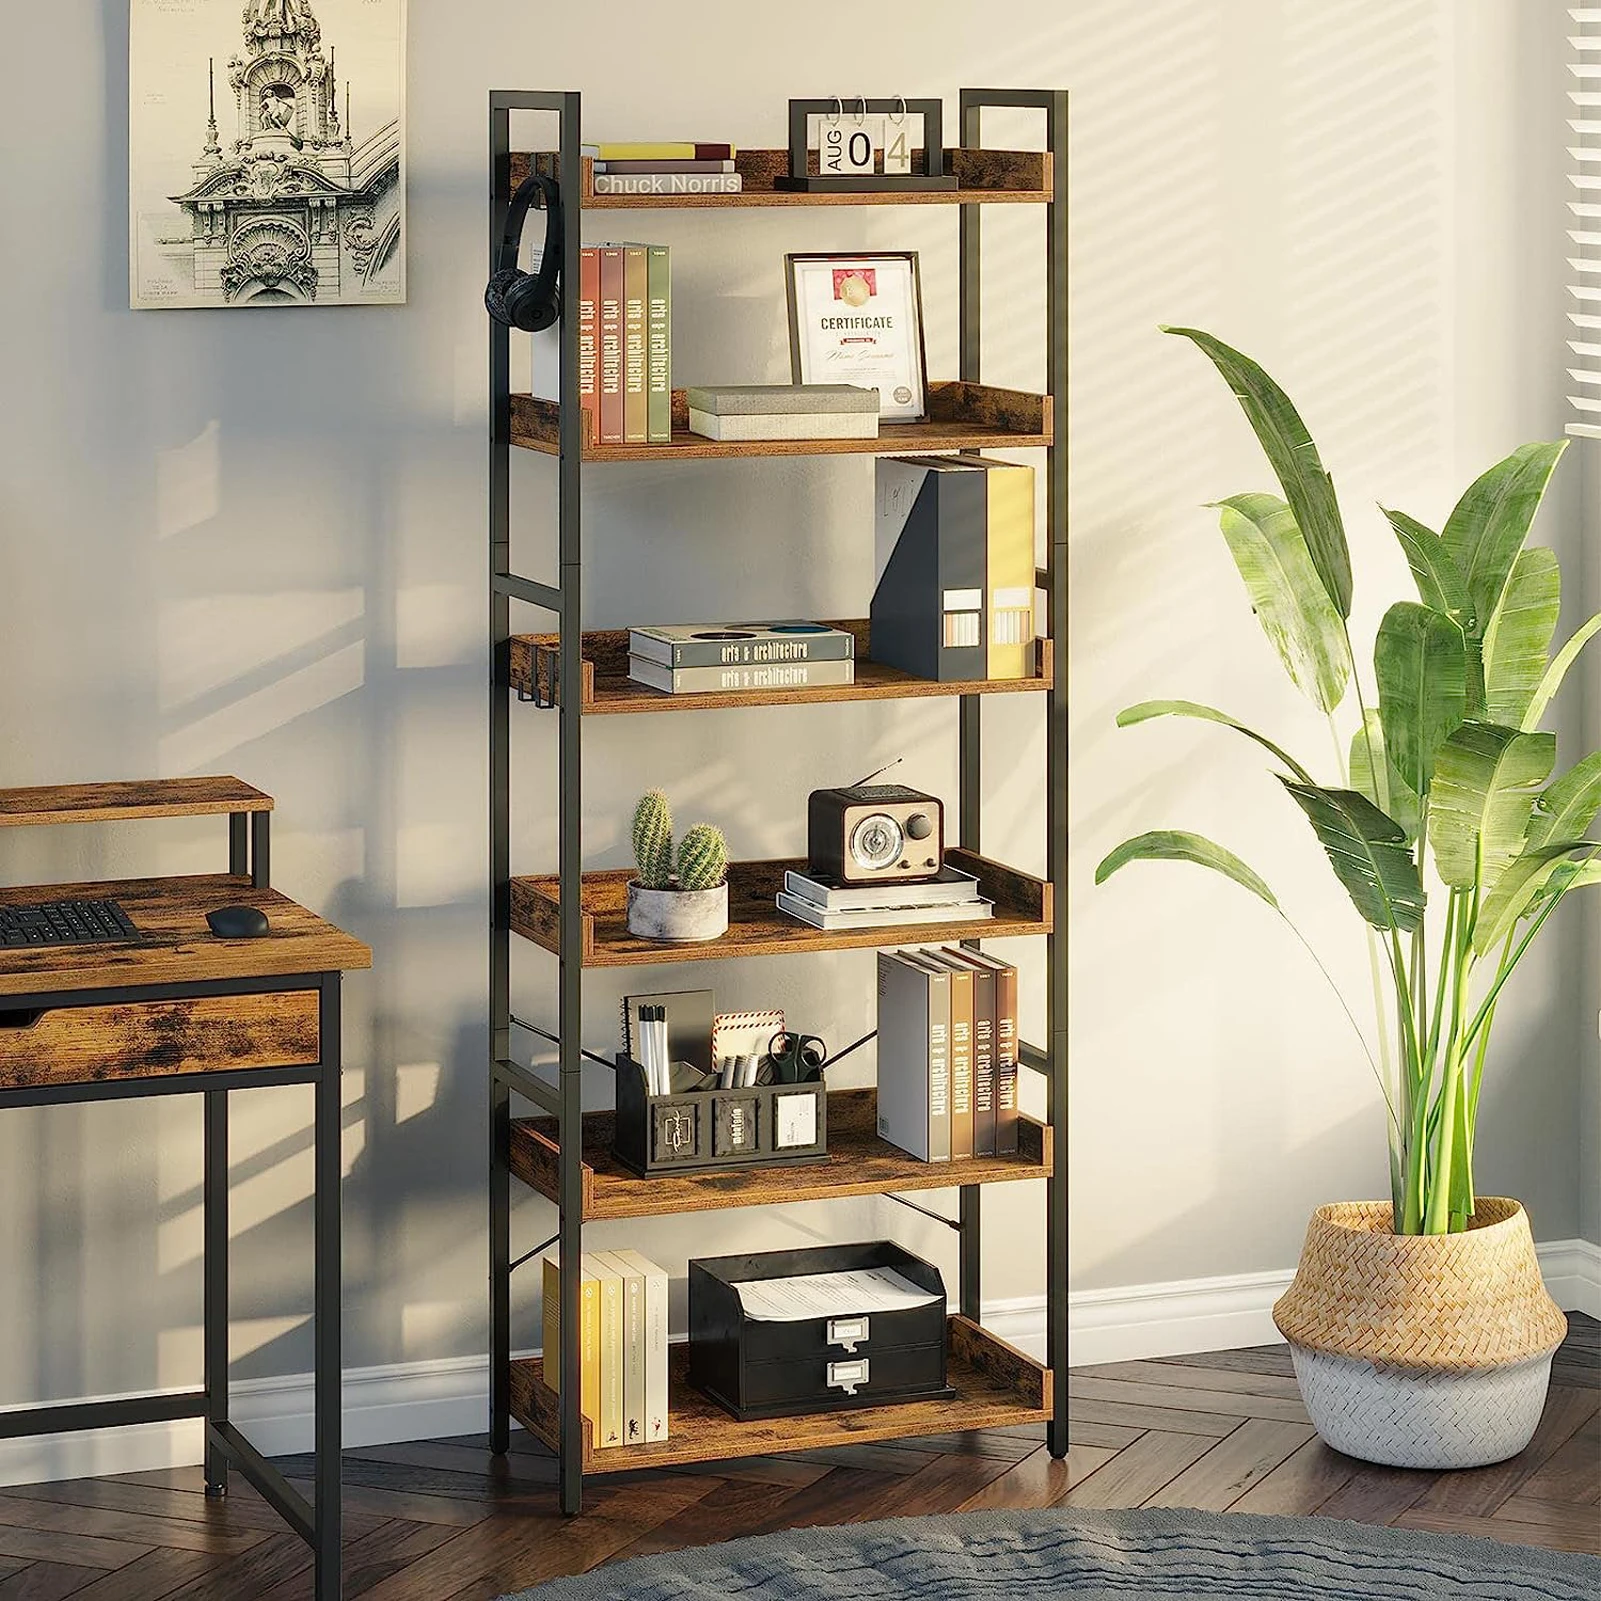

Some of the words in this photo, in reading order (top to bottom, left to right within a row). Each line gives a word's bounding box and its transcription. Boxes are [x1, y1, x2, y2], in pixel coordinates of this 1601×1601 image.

[827, 130, 842, 171] AUG
[849, 132, 871, 167] 0
[887, 132, 909, 168] 4
[595, 174, 665, 193] Chuck
[672, 174, 739, 193] Norris
[581, 300, 594, 319] arts
[604, 300, 619, 319] arts
[628, 299, 644, 318] arts
[652, 298, 667, 318] arts
[821, 316, 894, 330] CERTIFICATE
[581, 334, 596, 394] architecture
[604, 334, 620, 394] architecture
[628, 334, 644, 393] architecture
[652, 334, 668, 392] architecture
[721, 645, 740, 663] arts
[744, 647, 751, 661] &
[753, 641, 808, 661] architecture
[721, 669, 740, 688] arts
[744, 672, 751, 686] &
[753, 666, 808, 685] architecture
[932, 1024, 947, 1044] arts
[955, 1022, 970, 1041] arts
[978, 1020, 992, 1040] arts
[1000, 1018, 1014, 1037] arts
[932, 1058, 948, 1116] architecture
[955, 1056, 970, 1114] architecture
[978, 1054, 992, 1112] architecture
[1000, 1052, 1015, 1110] architecture
